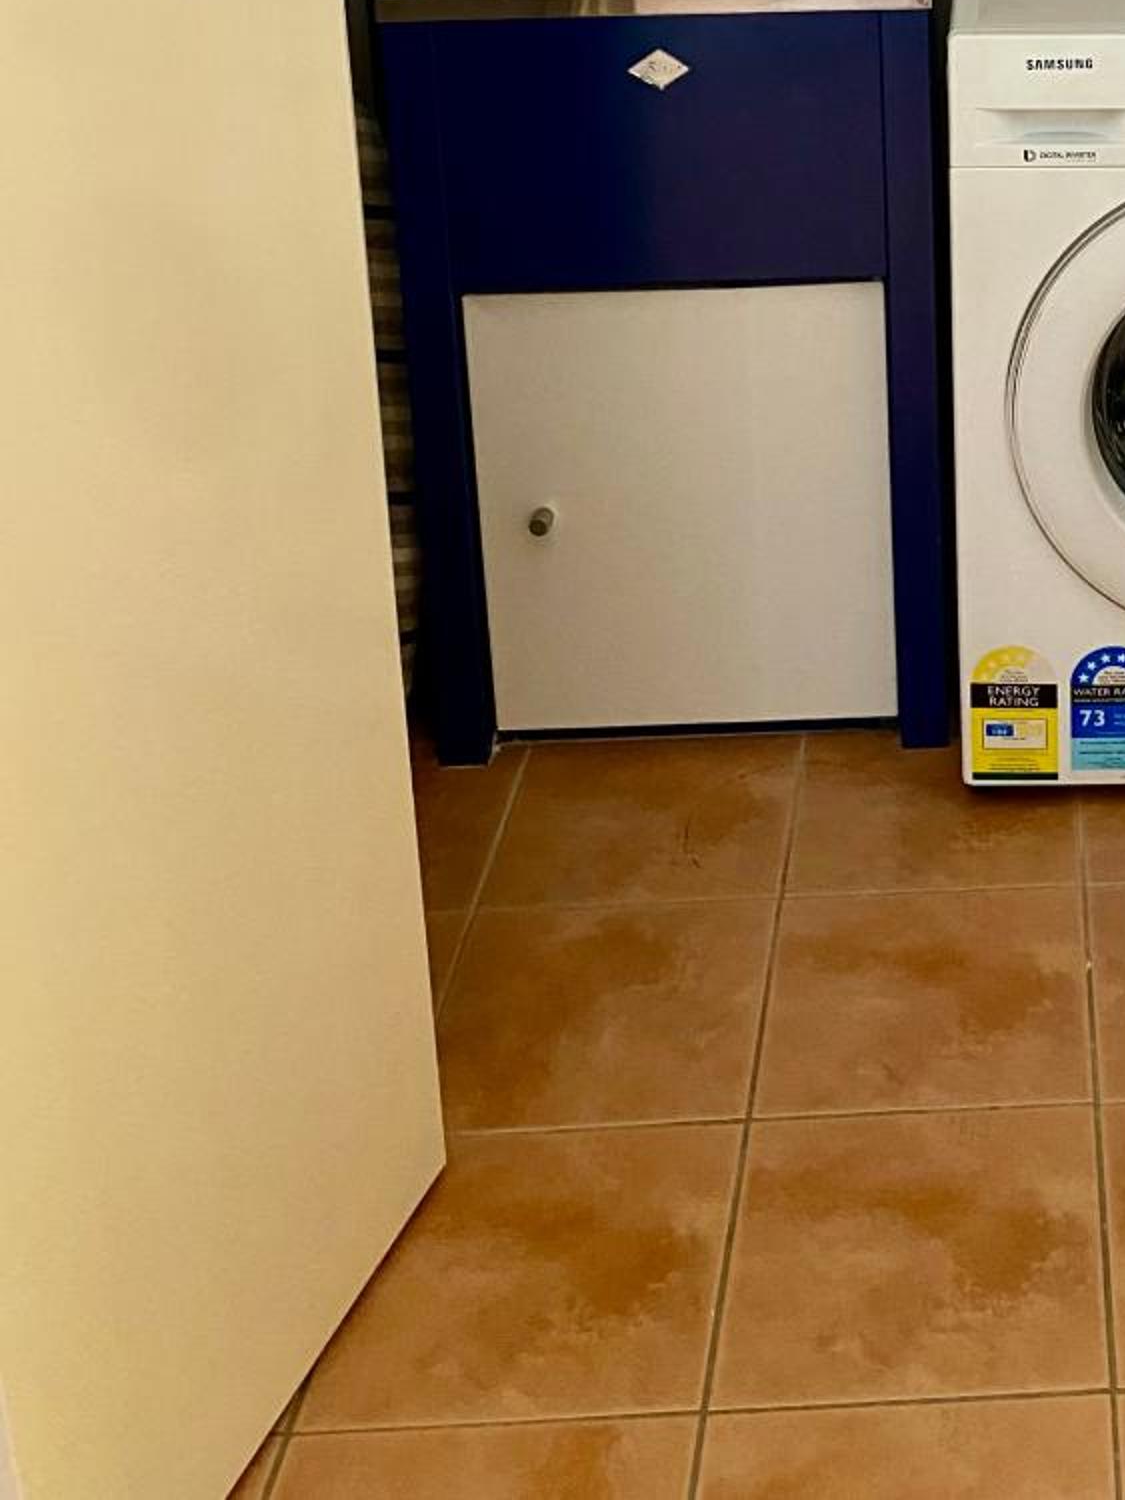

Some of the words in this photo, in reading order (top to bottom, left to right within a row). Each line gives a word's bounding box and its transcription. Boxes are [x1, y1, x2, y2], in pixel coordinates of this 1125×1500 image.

[1026, 58, 1093, 70] SAMSUNG
[987, 685, 1040, 696] ENERGY
[1073, 687, 1111, 697] WATER
[989, 697, 1039, 707] RATING
[1079, 708, 1106, 727] 73
